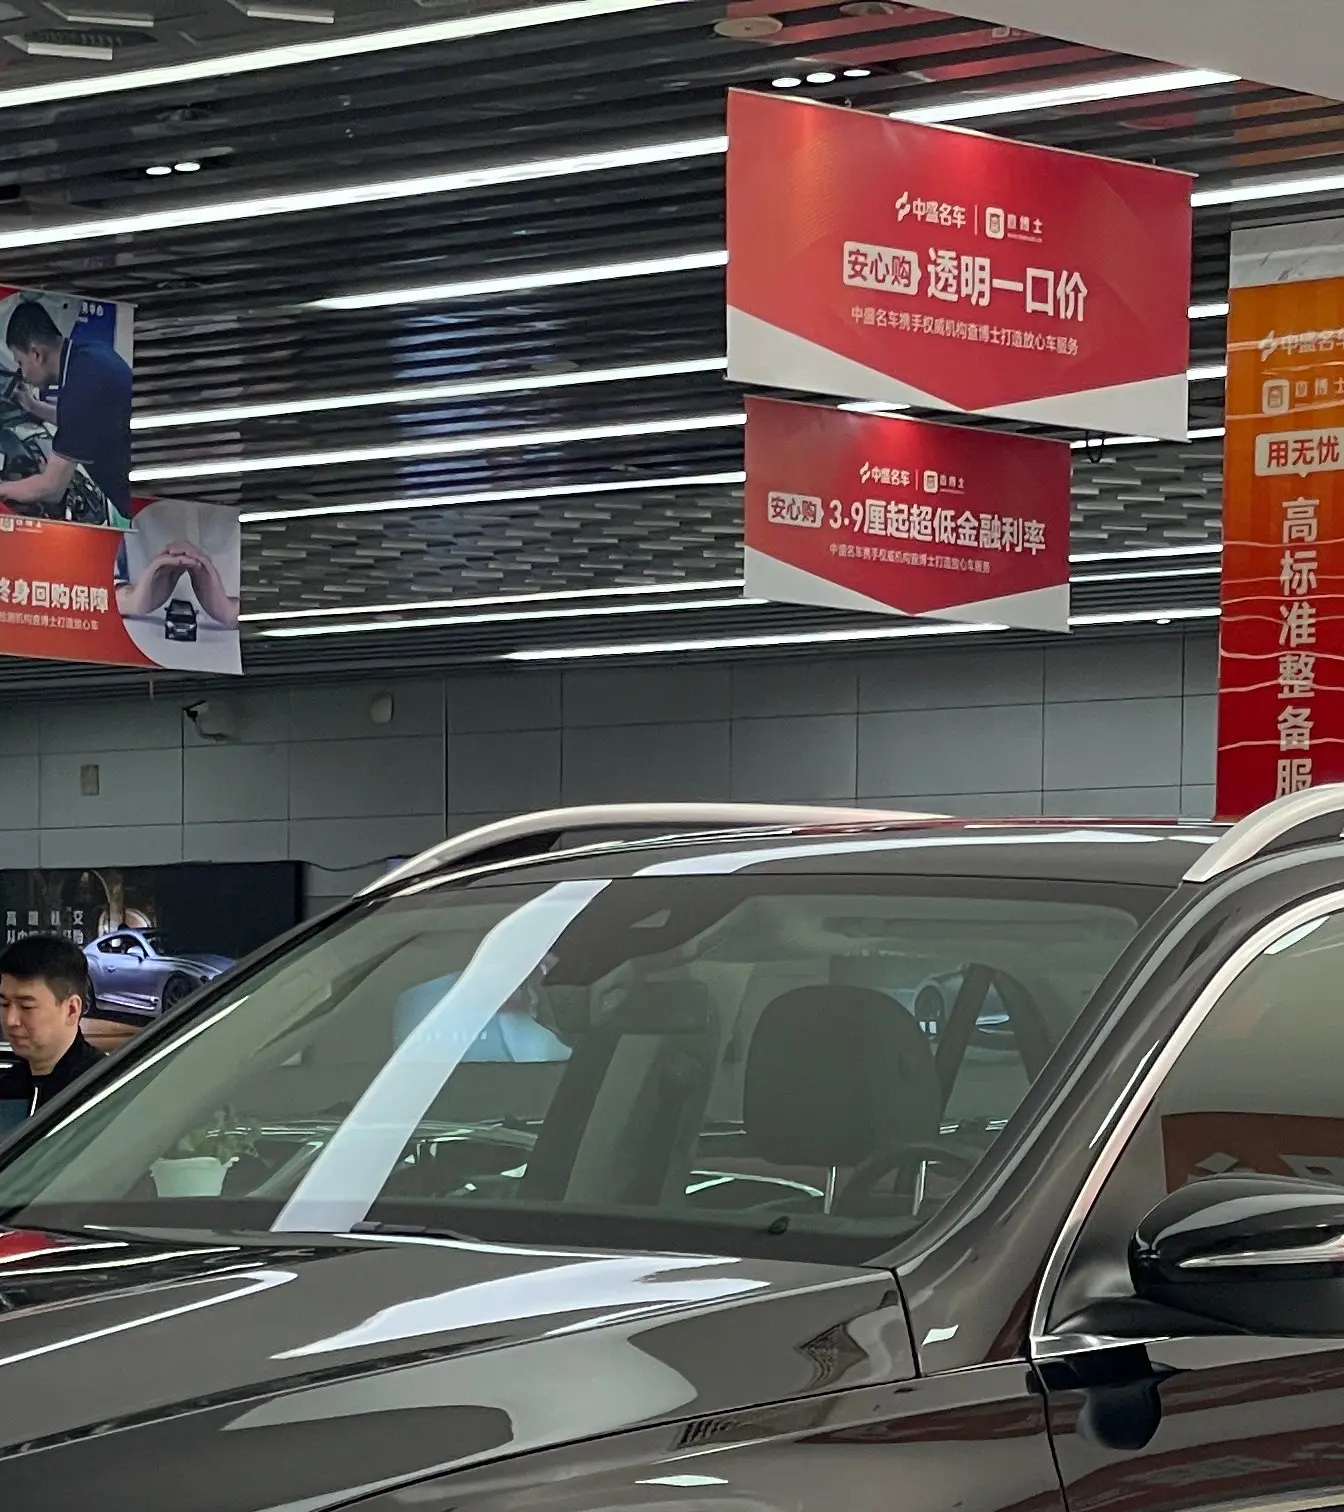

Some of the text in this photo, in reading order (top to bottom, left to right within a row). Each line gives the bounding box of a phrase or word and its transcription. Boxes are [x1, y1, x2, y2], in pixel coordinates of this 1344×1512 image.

[913, 198, 967, 229] 中盛名车
[847, 247, 1088, 322] 安心购 透明一口价
[1267, 435, 1340, 469] 用无忧
[871, 466, 910, 487] 中盛名车
[771, 496, 1046, 556] 安心购 3.9厘起超低金融利率
[1275, 496, 1320, 800] 高标准整备服
